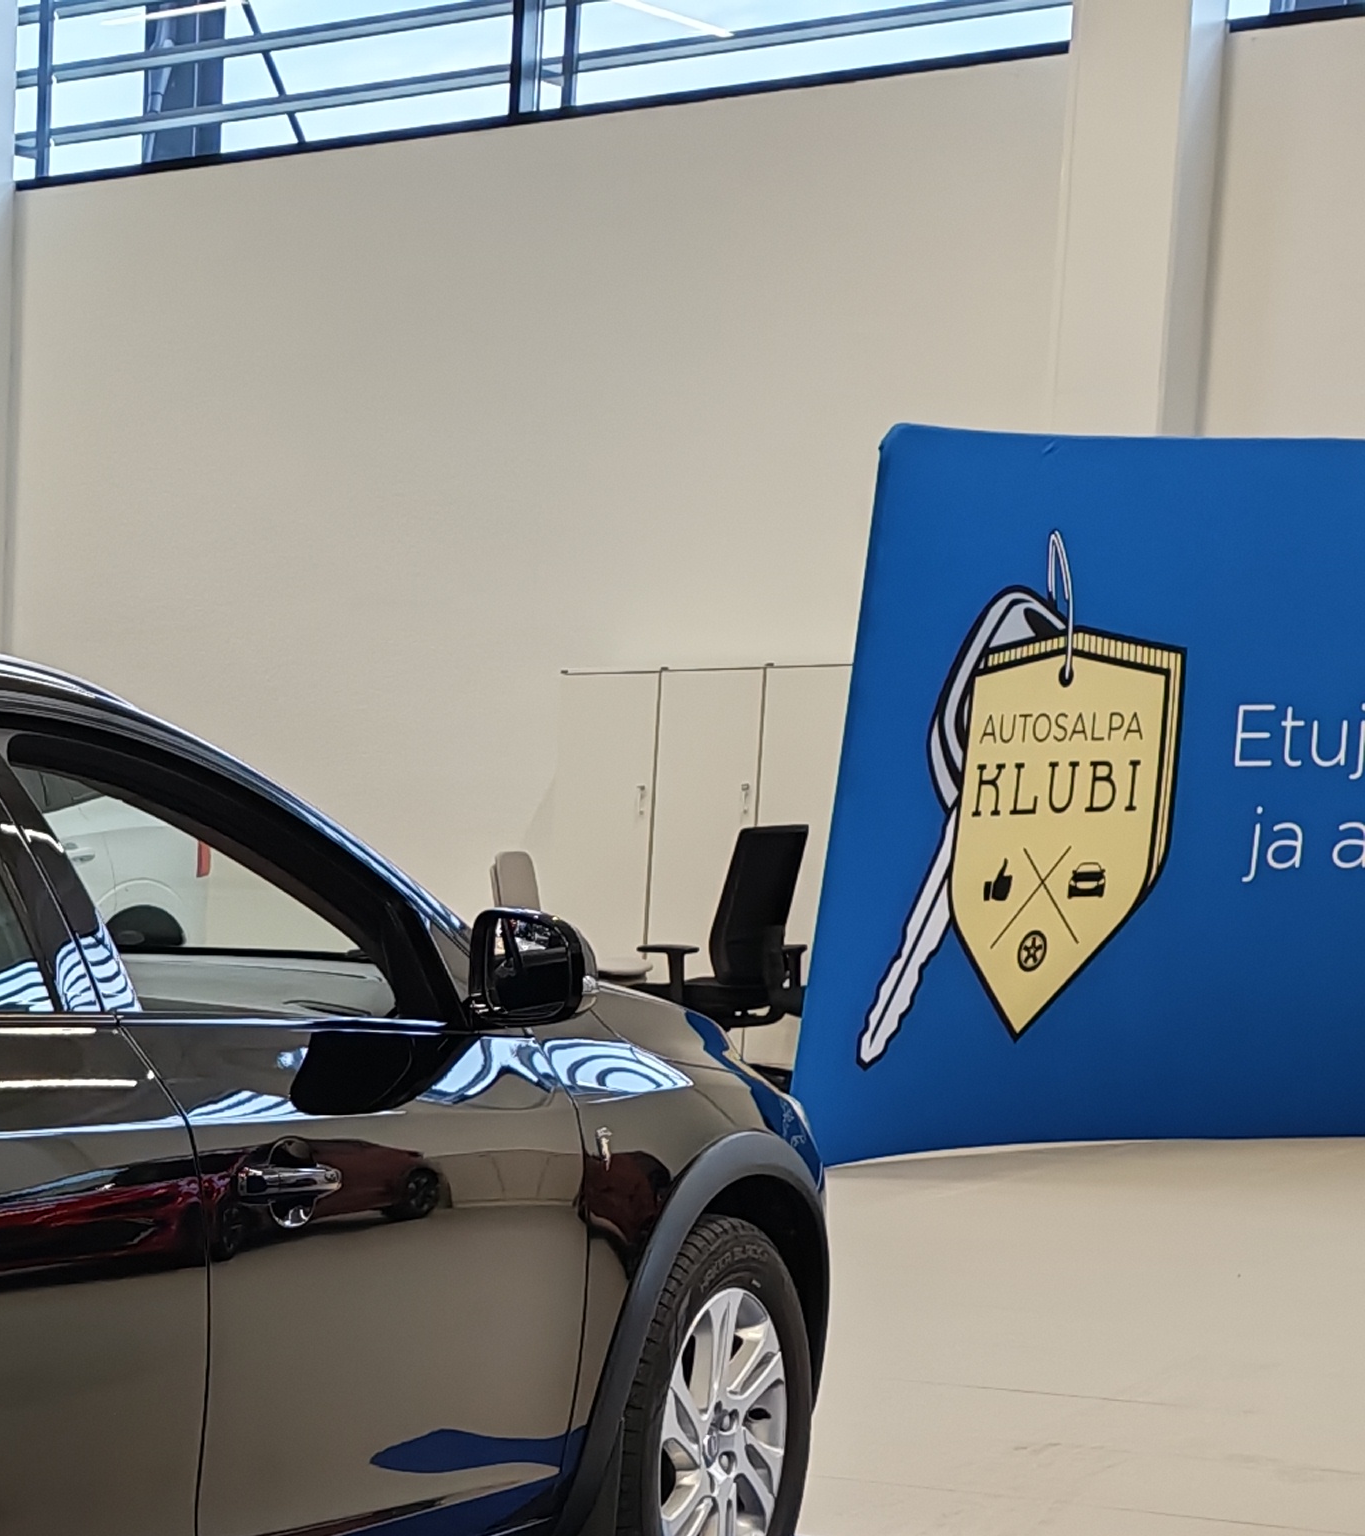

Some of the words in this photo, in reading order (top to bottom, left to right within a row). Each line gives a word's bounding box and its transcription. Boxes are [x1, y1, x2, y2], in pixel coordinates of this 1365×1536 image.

[979, 711, 1144, 744] AUTOSALPA
[1233, 703, 1365, 780] Etuj
[971, 759, 1141, 817] KLUBI
[1241, 805, 1304, 883] ja
